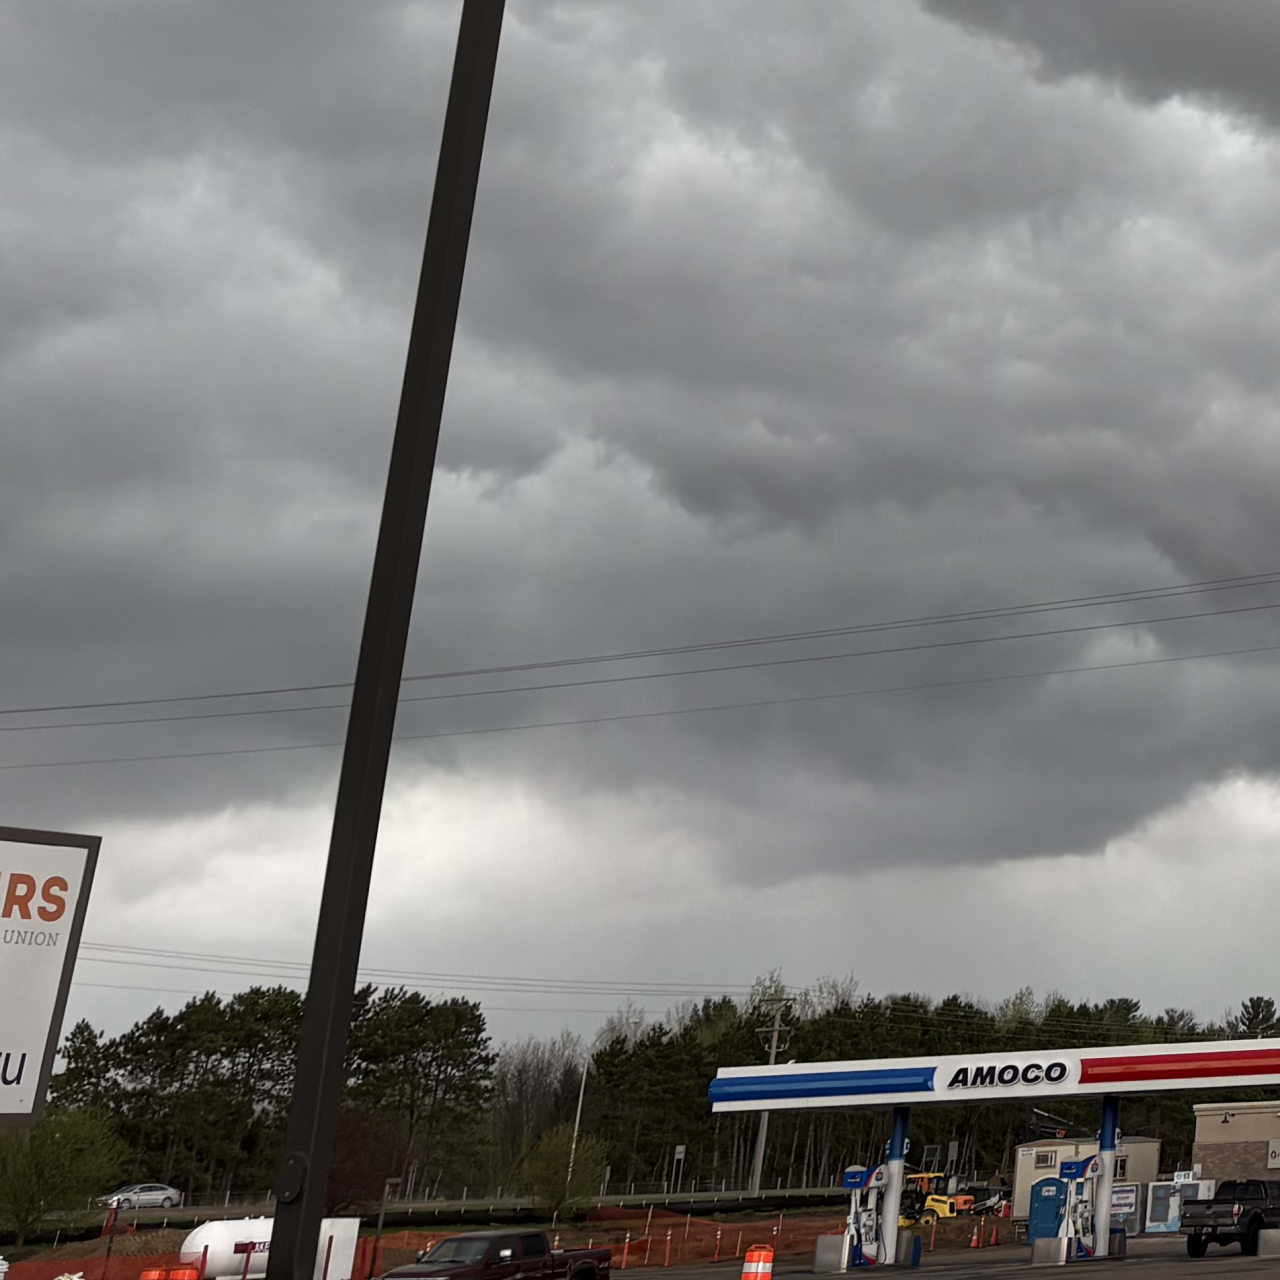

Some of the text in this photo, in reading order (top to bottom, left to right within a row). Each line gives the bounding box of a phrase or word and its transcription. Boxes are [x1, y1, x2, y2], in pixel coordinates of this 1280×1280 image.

[0, 872, 69, 923] RS
[3, 929, 59, 947] UNION
[947, 1062, 1068, 1088] AMOCO
